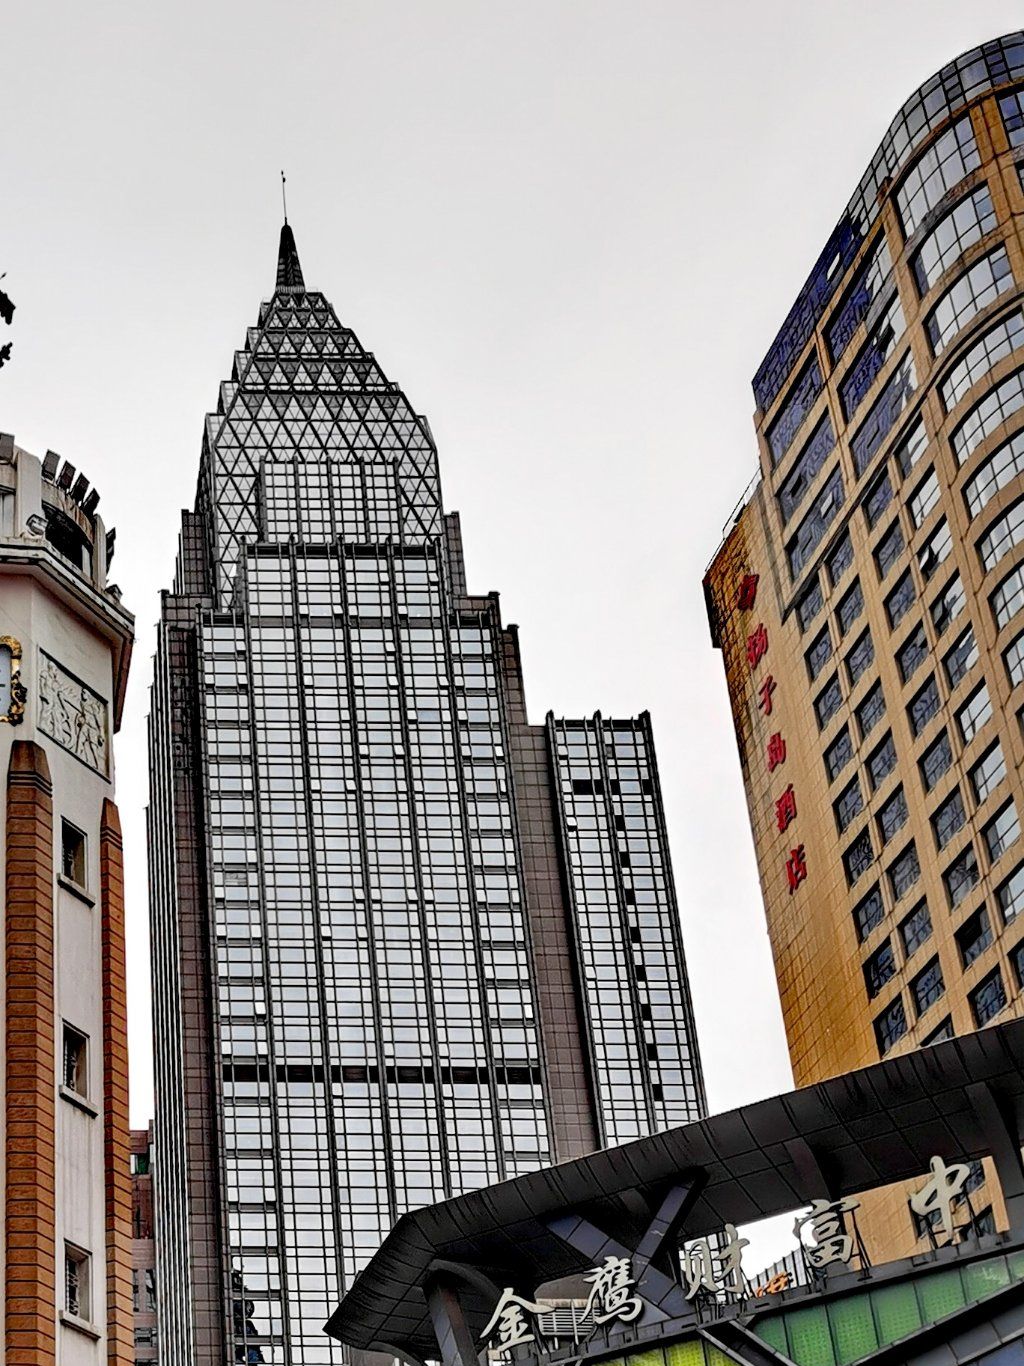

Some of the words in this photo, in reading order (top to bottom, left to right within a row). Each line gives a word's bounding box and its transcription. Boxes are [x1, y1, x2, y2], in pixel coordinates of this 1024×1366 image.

[480, 1155, 971, 1353] 金鹰财富中
